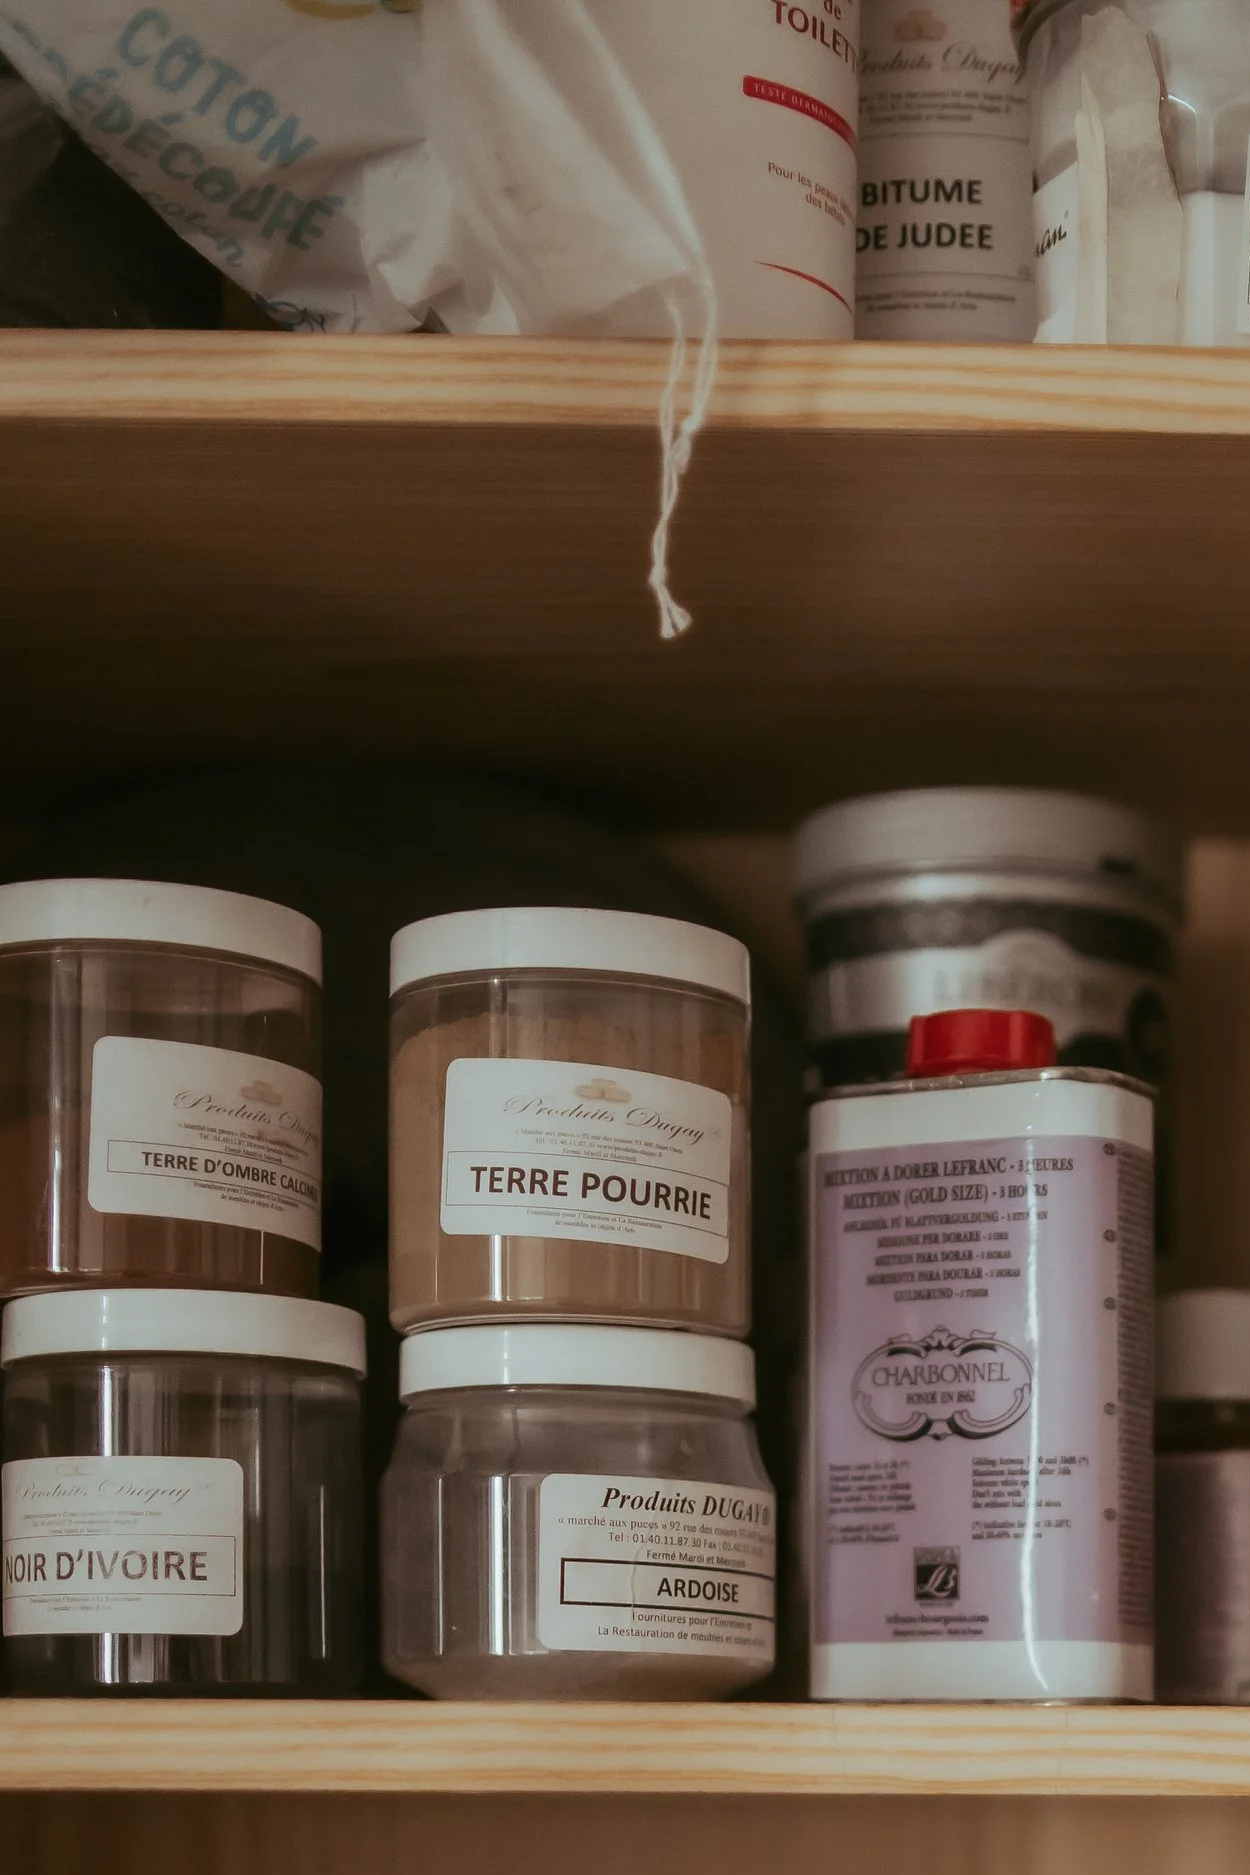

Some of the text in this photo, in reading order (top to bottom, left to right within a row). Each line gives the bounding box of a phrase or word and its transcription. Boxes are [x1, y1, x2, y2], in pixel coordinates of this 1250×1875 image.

[118, 8, 317, 169] COTON
[768, 161, 793, 181] Pour
[861, 178, 983, 207] BITUME
[856, 222, 994, 251] DE JUDEE
[173, 1090, 272, 1125] Produits
[503, 1094, 705, 1145] Produits Dugay
[141, 1151, 198, 1172] TERRE
[204, 1158, 276, 1186] D'OMBRE
[882, 1166, 891, 1181] A
[894, 1161, 940, 1180] DORER
[943, 1157, 1007, 1177] LEFRANC
[1027, 1157, 1074, 1175] EURES
[470, 1166, 712, 1220] TERRE POURRIE
[872, 1362, 1010, 1387] CHARBONNEL
[601, 1486, 696, 1515] Produits
[568, 1515, 697, 1533] marché aux puces 92 rue
[4, 1549, 208, 1585] NOIR D'IVOIRE
[646, 1549, 676, 1561] Fermé
[656, 1576, 739, 1603] ARDOISE
[597, 1625, 609, 1637] La
[612, 1626, 675, 1640] Restauration
[677, 1629, 689, 1640] de
[632, 1611, 687, 1625] Fournitures
